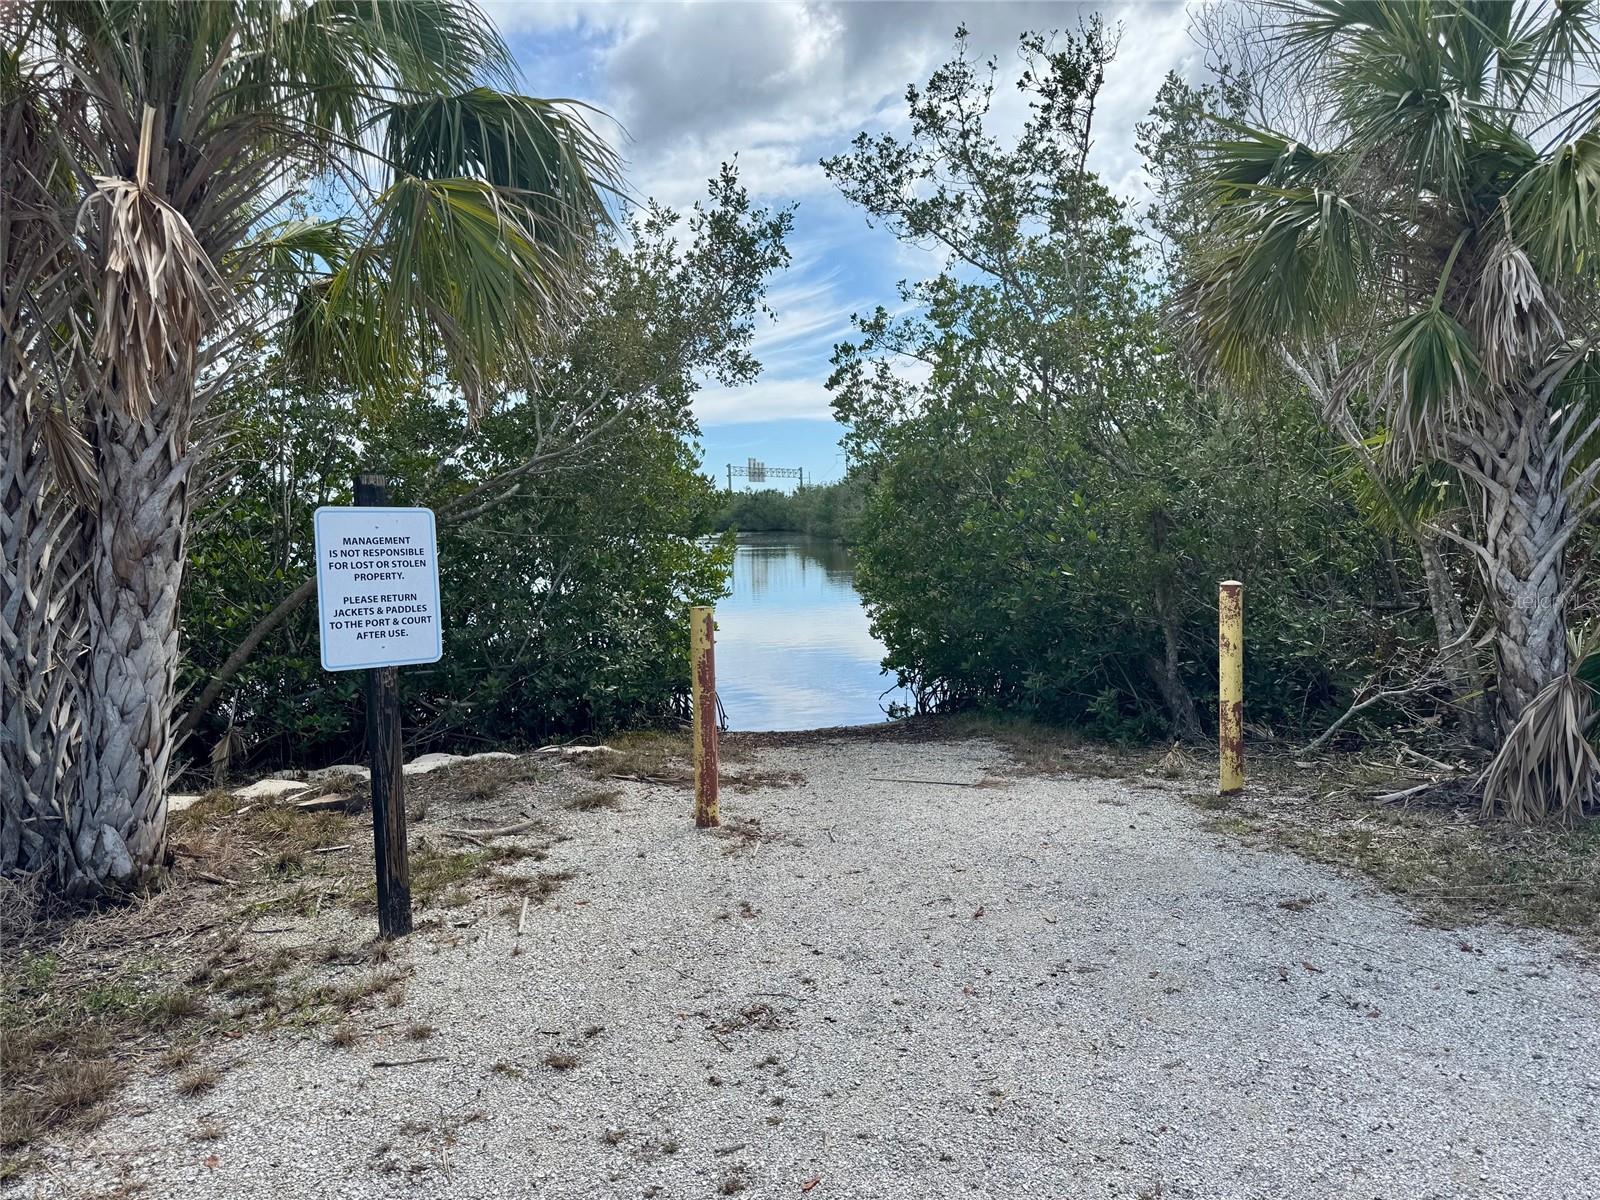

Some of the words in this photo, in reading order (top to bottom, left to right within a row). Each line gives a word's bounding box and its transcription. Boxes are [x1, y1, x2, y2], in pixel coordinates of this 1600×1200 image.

[343, 537, 411, 545] MANAGEMENT
[329, 550, 338, 558] IS
[340, 549, 360, 557] NOT
[363, 548, 424, 557] RESPONSIBLE
[329, 562, 348, 570] FOR
[351, 561, 374, 570] LOST
[391, 560, 426, 568] STOLEN
[354, 572, 405, 581] PROPERTY.
[343, 595, 378, 604] PLEASE
[381, 594, 417, 602] RETURN
[333, 607, 374, 617] JACKETS
[386, 605, 427, 614] PADDLES
[329, 622, 342, 630] TO
[345, 620, 363, 628] THE
[365, 618, 390, 627] PORT
[401, 616, 432, 625] COURT
[356, 631, 386, 640] AFTER
[388, 629, 408, 637] USE.
